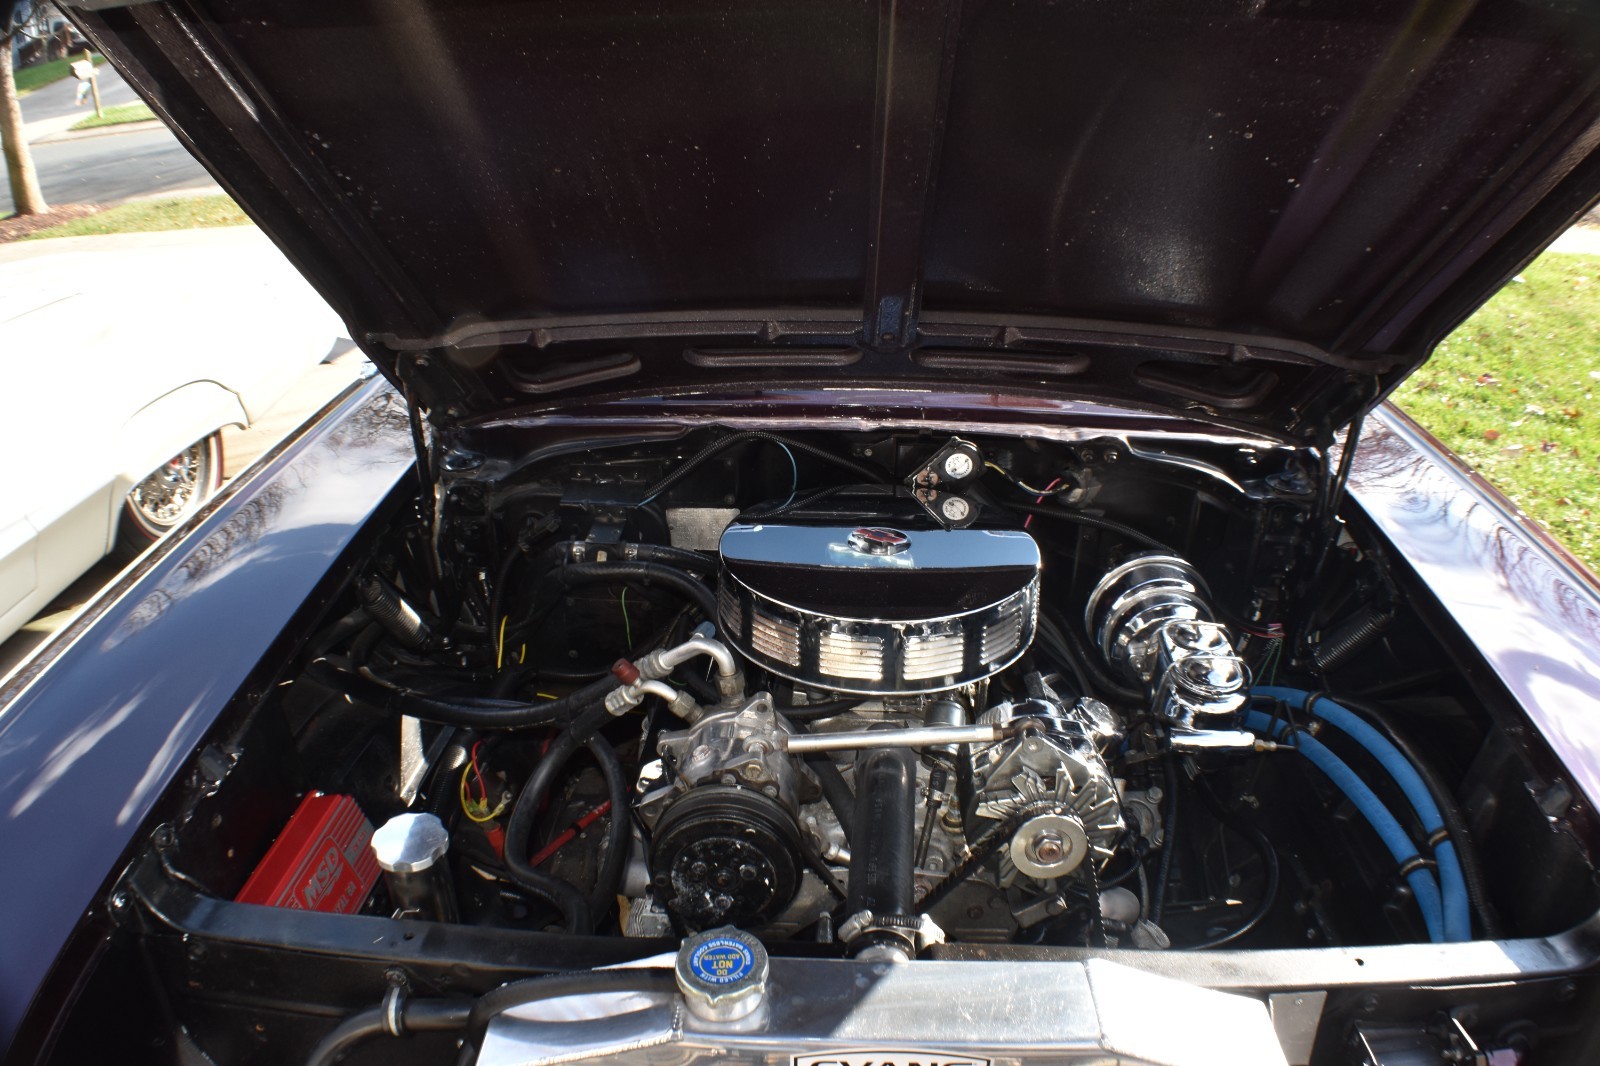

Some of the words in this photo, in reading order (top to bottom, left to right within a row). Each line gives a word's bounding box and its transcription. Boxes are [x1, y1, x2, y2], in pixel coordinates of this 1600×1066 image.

[304, 847, 338, 909] MSD
[712, 960, 733, 969] NOT
[700, 972, 717, 983] WITH
[720, 972, 744, 983] FILLED
